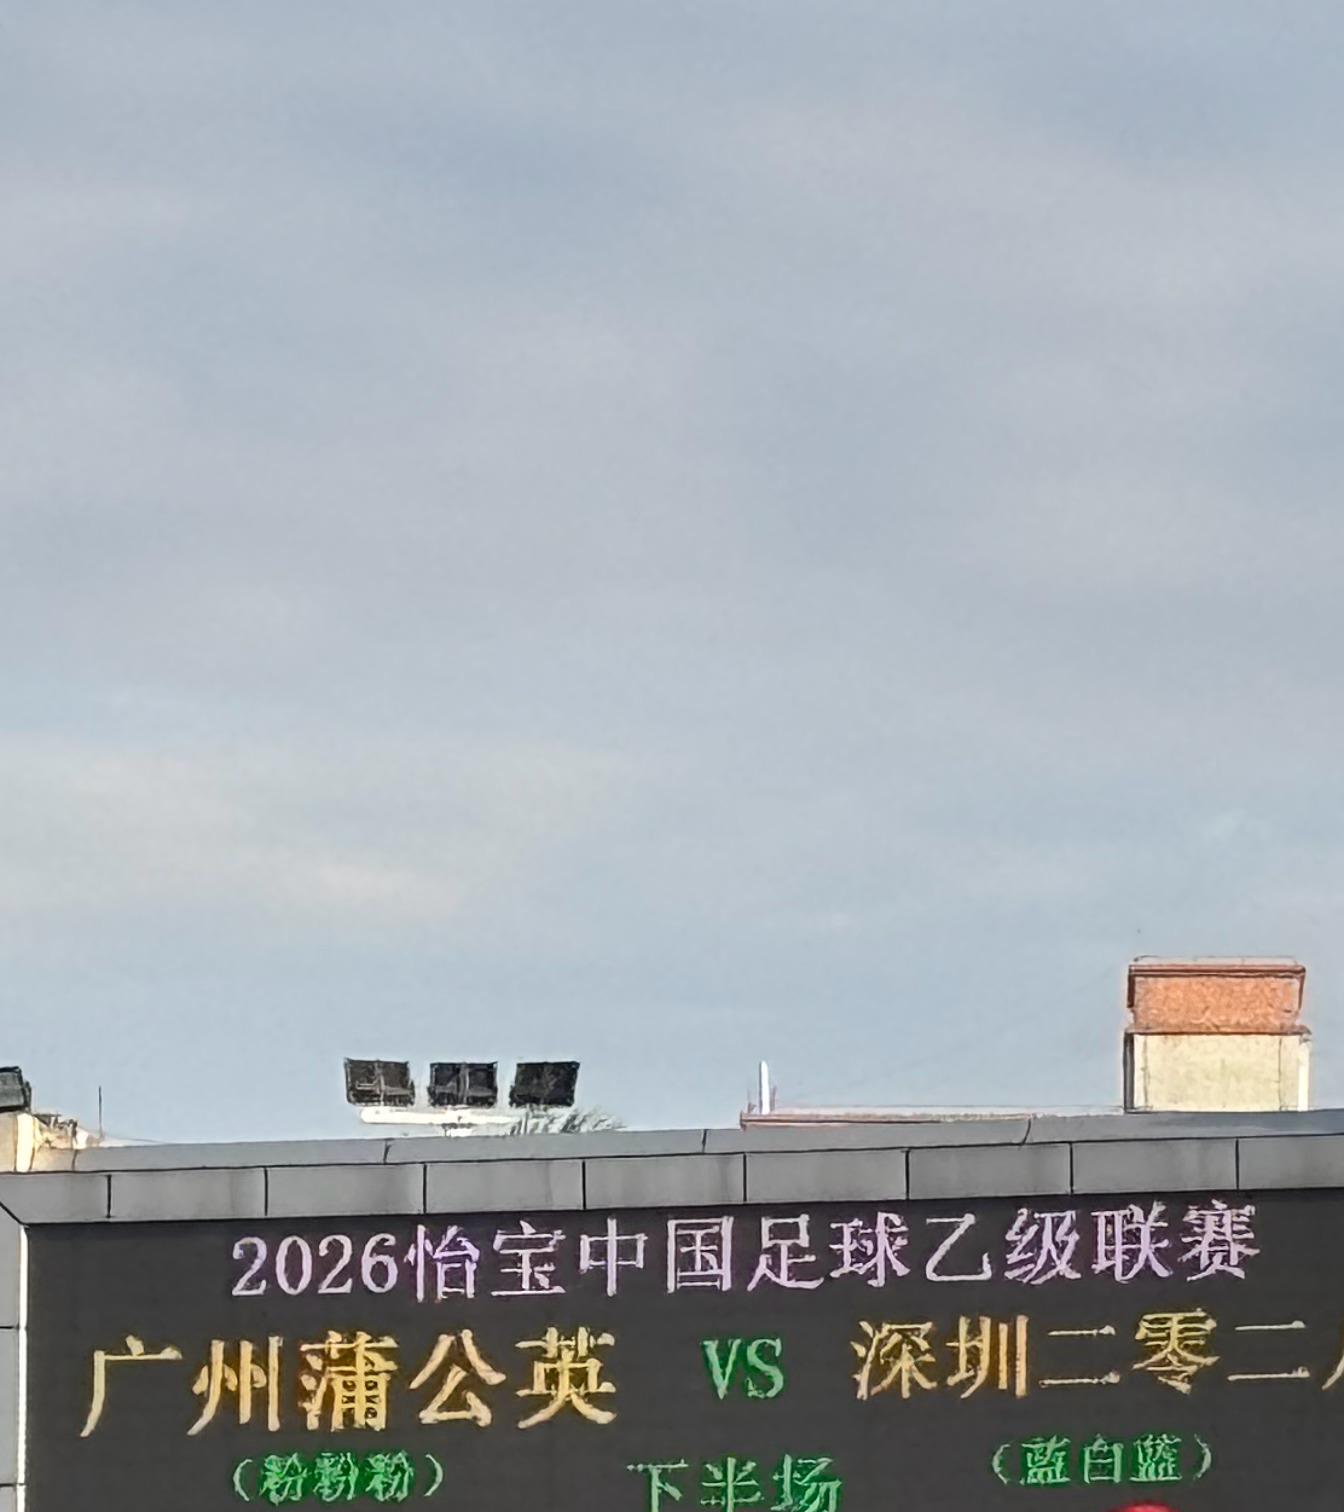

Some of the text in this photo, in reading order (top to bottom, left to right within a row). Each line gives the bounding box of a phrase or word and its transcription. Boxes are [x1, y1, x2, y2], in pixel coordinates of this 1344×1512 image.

[230, 1200, 1261, 1303] 2026怡宝中国足球乙级联赛
[80, 1327, 617, 1438] 广州蒲公英
[702, 1337, 784, 1400] VS
